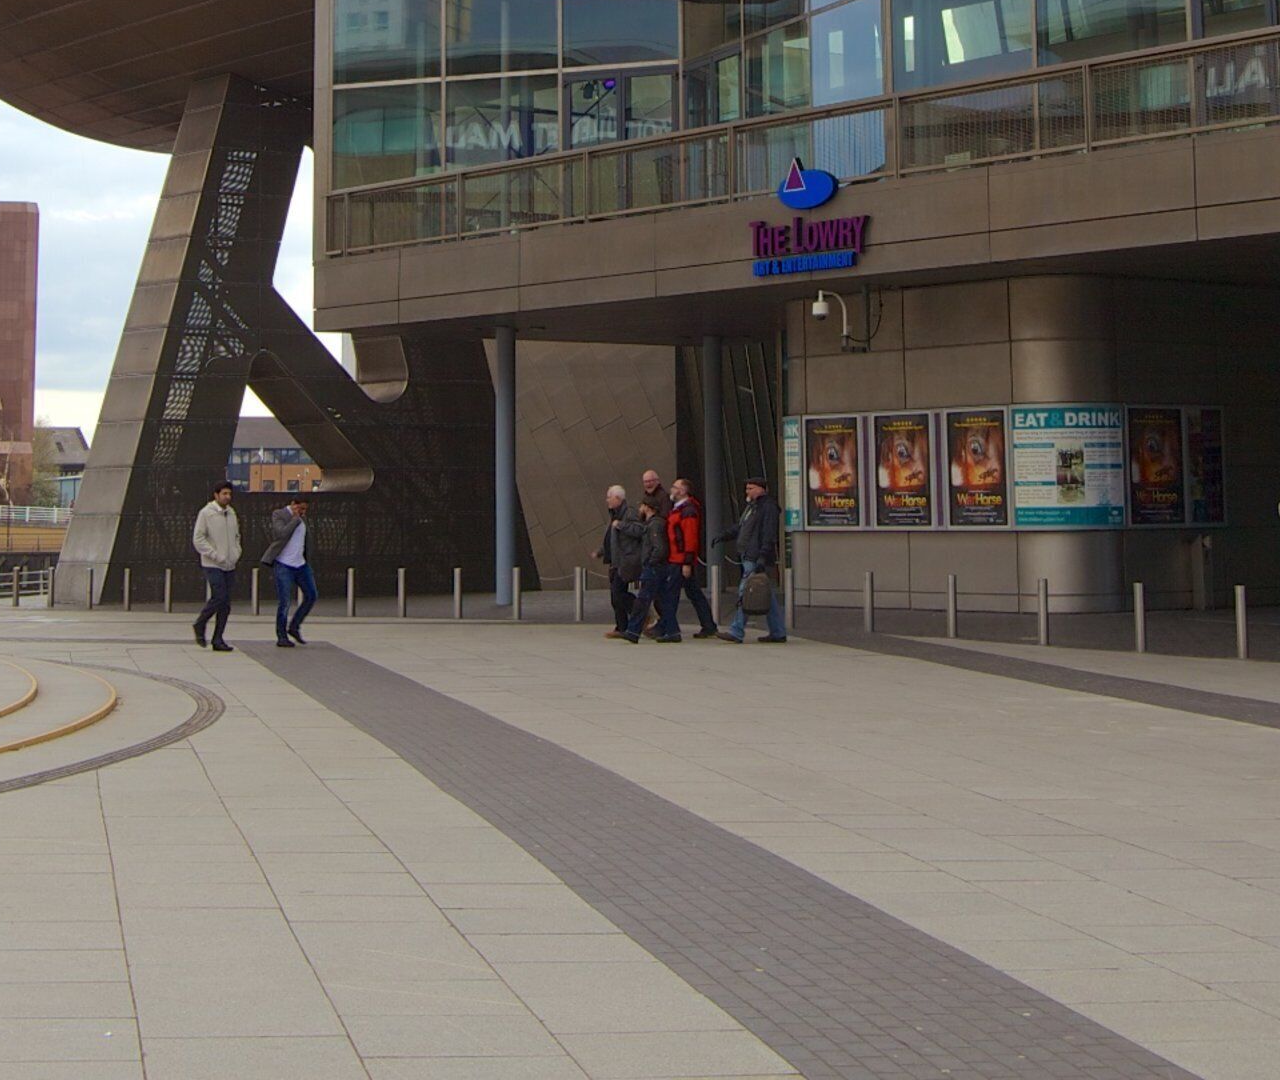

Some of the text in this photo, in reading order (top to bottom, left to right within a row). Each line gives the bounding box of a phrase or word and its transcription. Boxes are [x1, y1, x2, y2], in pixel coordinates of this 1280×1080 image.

[748, 215, 871, 258] THE LOWRY
[781, 250, 857, 274] ENTERTAINMENT
[1014, 411, 1120, 428] EAT & DRINK
